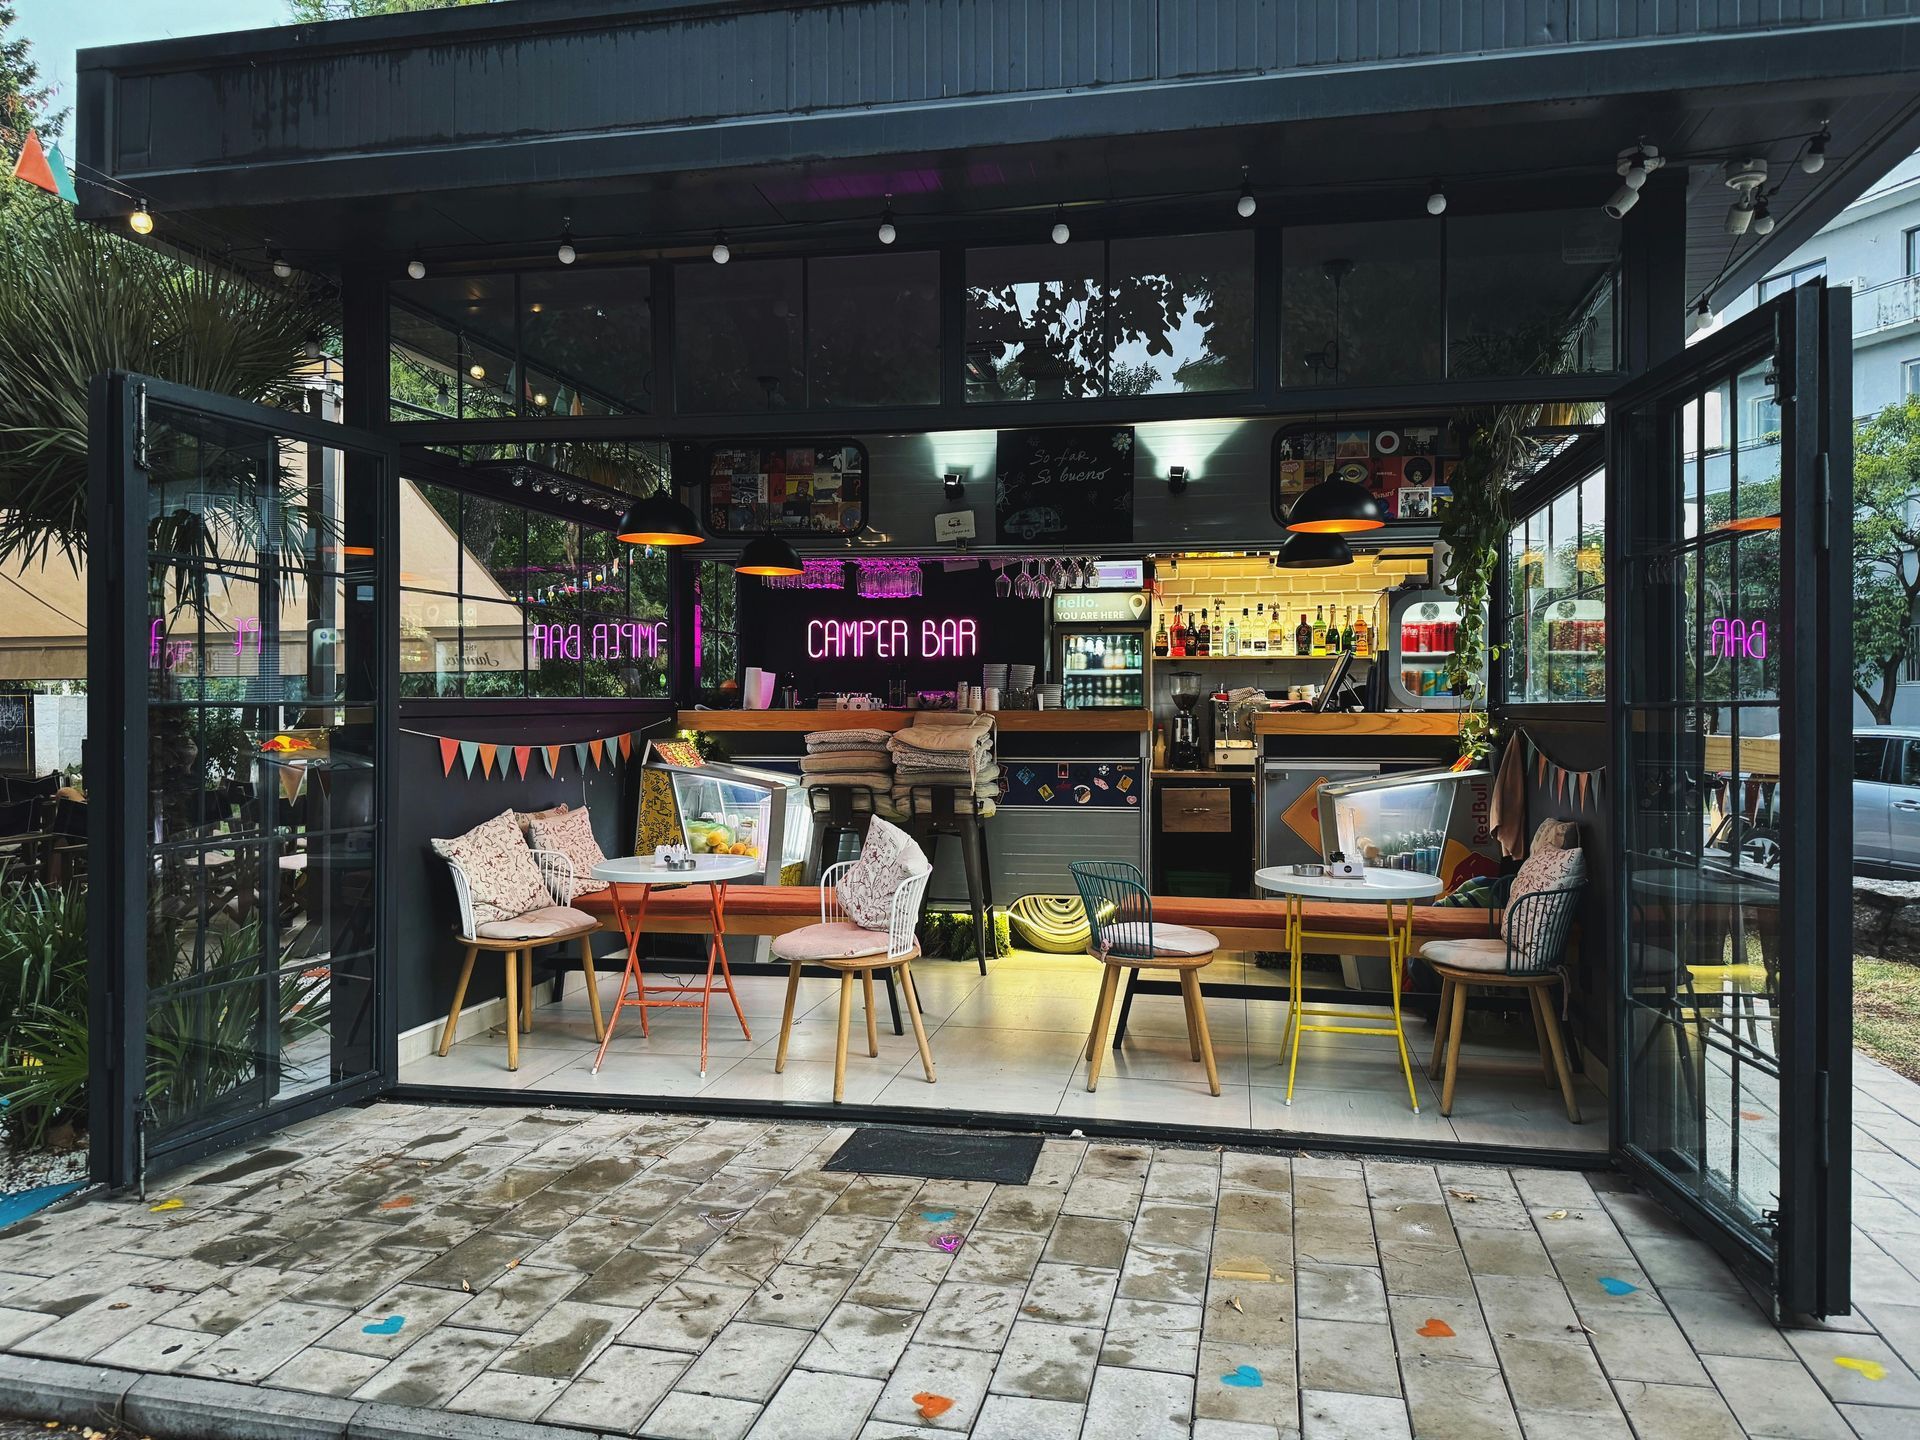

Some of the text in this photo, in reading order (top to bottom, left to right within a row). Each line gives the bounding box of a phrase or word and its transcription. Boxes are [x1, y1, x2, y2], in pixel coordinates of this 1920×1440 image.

[1029, 449, 1050, 465] So
[1031, 467, 1112, 485] So bueno
[1057, 596, 1099, 608] hello.
[1057, 611, 1125, 620] YOU ARE HERE
[807, 619, 977, 659] CAMPER BAR
